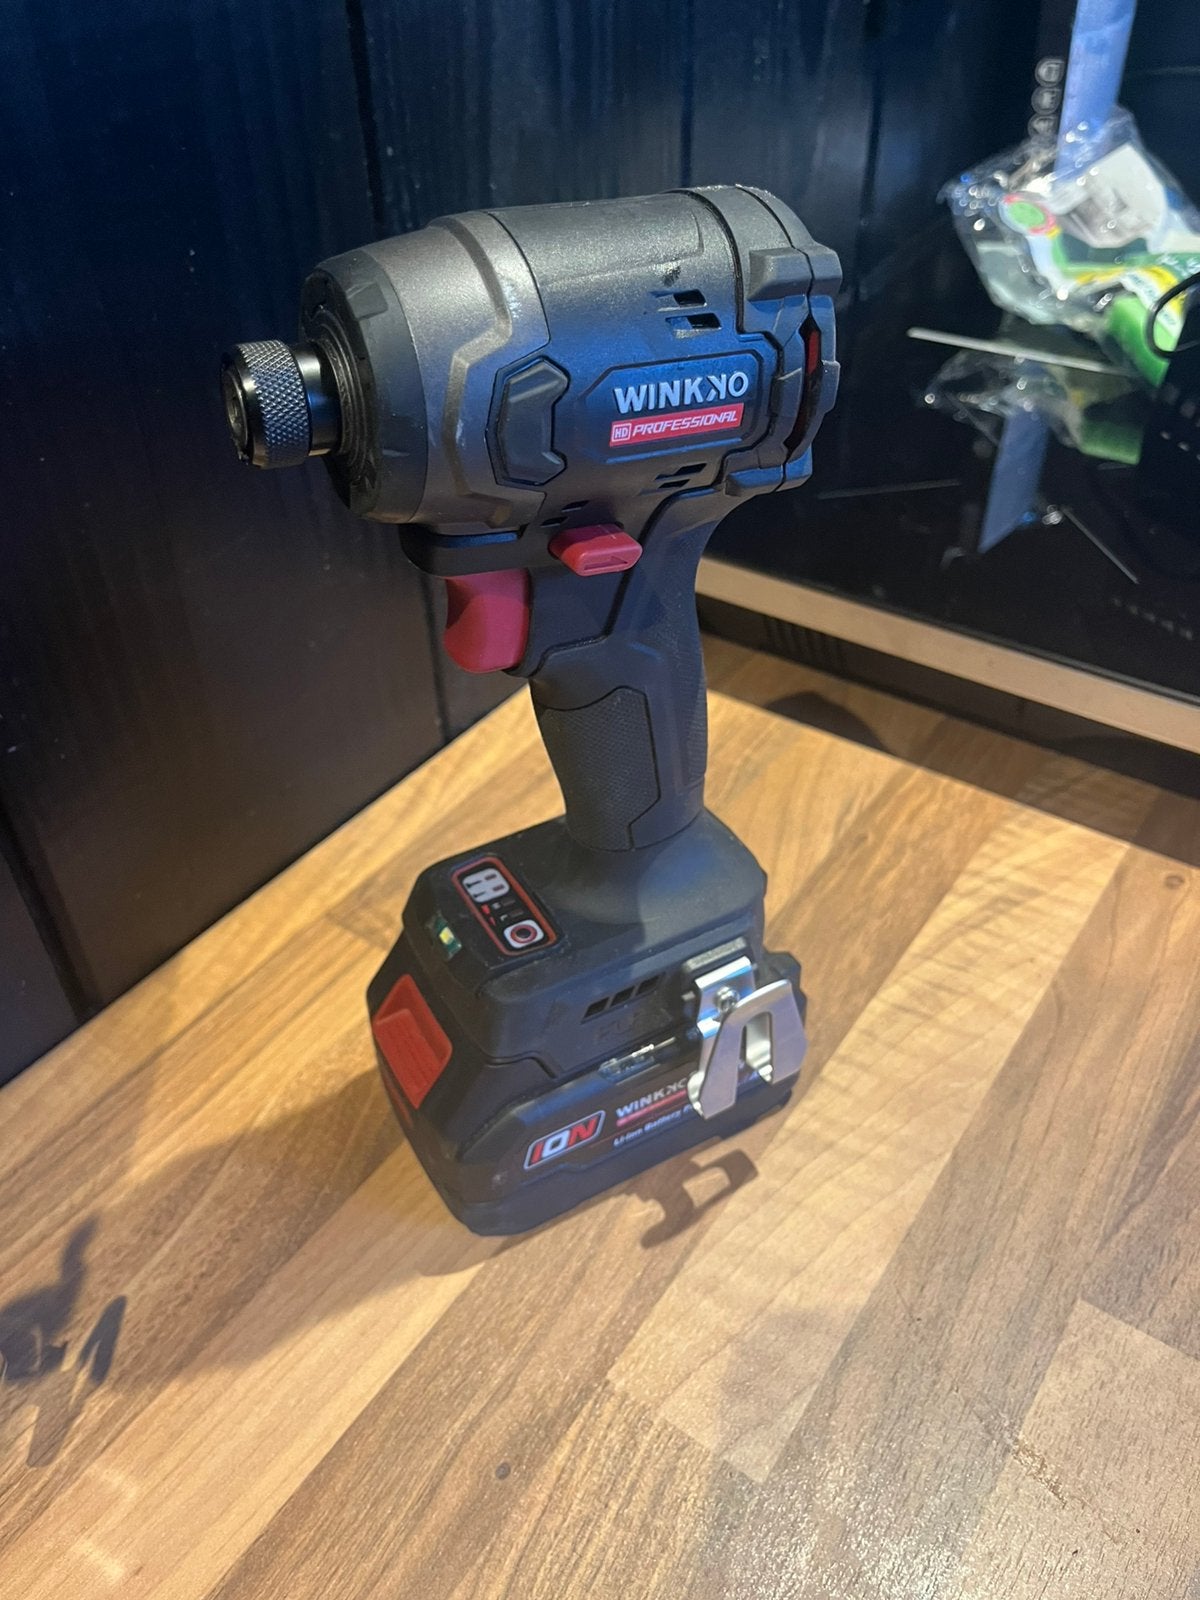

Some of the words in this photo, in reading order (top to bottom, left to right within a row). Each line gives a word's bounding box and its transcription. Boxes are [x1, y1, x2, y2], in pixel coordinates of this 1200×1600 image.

[614, 371, 749, 414] WINKKO
[613, 425, 630, 440] HD
[632, 410, 737, 437] PROFESSIONAL
